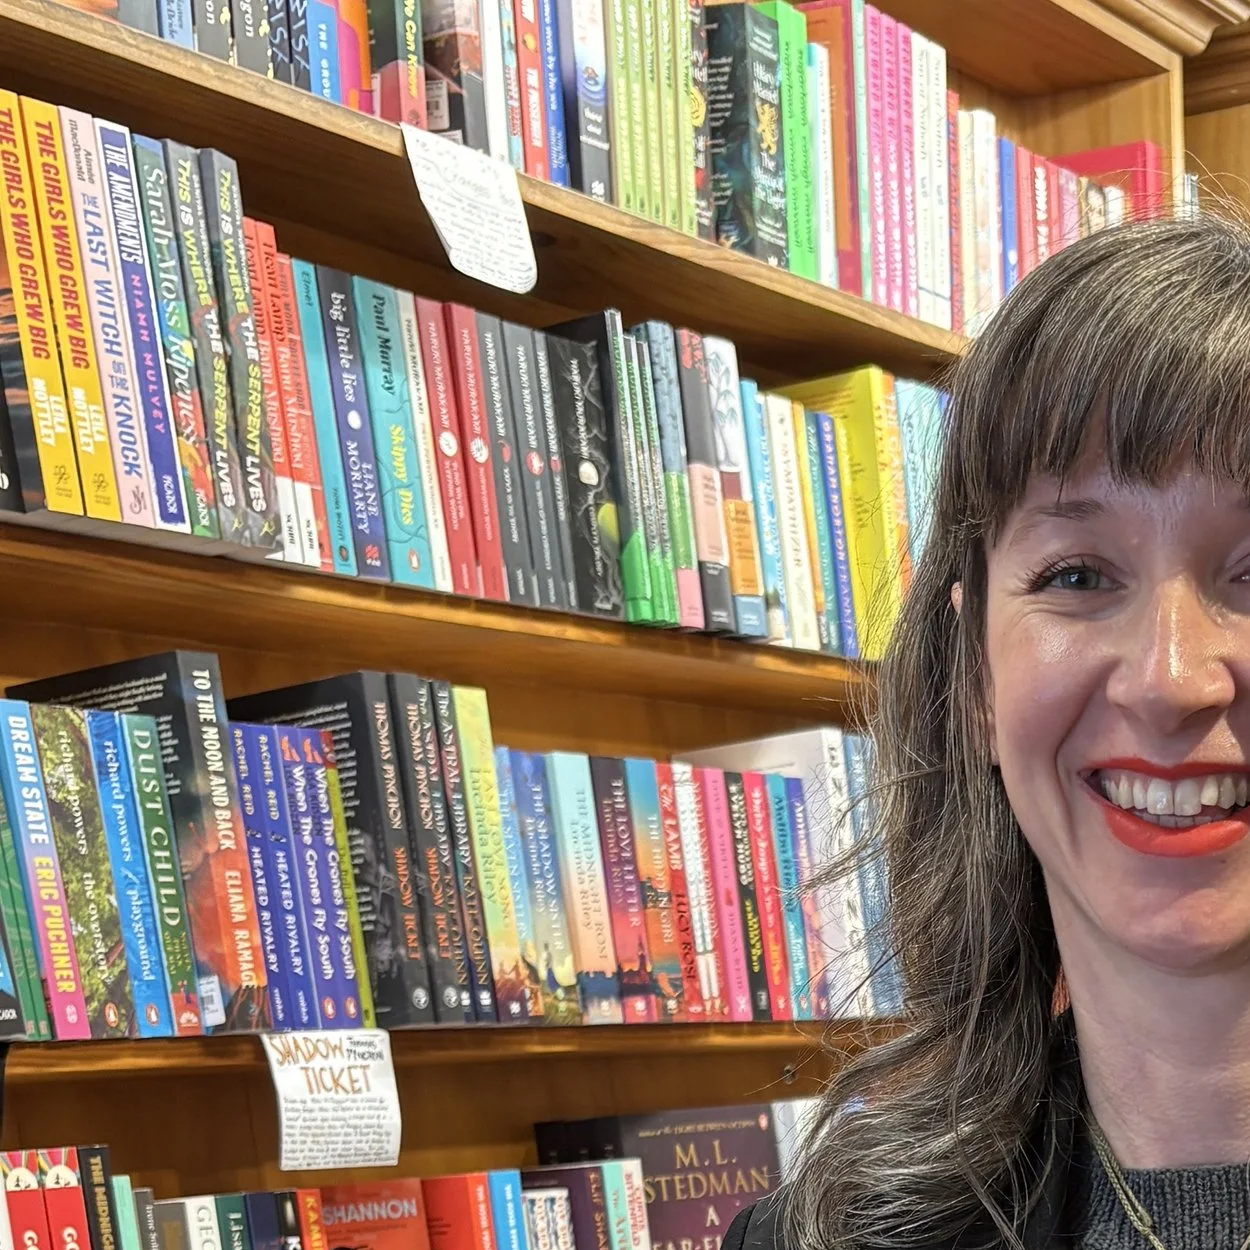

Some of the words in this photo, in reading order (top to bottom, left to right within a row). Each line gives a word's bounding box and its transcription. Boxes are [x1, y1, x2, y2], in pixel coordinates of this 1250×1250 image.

[34, 121, 57, 161] THE
[103, 143, 129, 172] THE
[2, 149, 26, 211] GIRLS
[42, 160, 64, 221] GIRLS
[145, 166, 175, 246] Sarah
[175, 158, 192, 204] THIS
[10, 212, 33, 260] WHO
[80, 206, 112, 273] LAST
[107, 169, 145, 266] AMENDMENTS
[179, 205, 194, 227] IS
[51, 220, 74, 271] WHO
[181, 229, 214, 307] WHERE
[19, 261, 45, 326] GREW
[60, 271, 85, 335] GREW
[157, 251, 183, 328] Moss
[329, 291, 346, 322] big
[371, 293, 391, 333] Paul
[28, 324, 51, 360] BIG
[93, 274, 124, 358] WITCH
[204, 308, 226, 352] THE
[69, 334, 90, 370] BIG
[335, 324, 354, 370] little
[376, 334, 397, 397] Murray
[212, 355, 230, 449] SERPENT
[342, 372, 358, 404] lies
[113, 394, 145, 479] KNOCK
[214, 449, 236, 508] LIVES
[345, 440, 370, 534] MORIARTY
[361, 462, 379, 517] LIANE
[192, 668, 213, 691] TO
[437, 686, 450, 718] The
[196, 695, 218, 724] THE
[7, 714, 38, 784] DREAM
[103, 740, 126, 801] richard
[201, 725, 225, 773] MOON
[258, 733, 275, 786] RACHEL
[441, 720, 461, 790] ASTRAL
[21, 786, 50, 846] STATE
[208, 774, 231, 809] AND
[267, 788, 280, 822] REID
[610, 777, 627, 812] THE
[111, 802, 133, 862] powers
[132, 728, 165, 816] DUST
[150, 826, 182, 927] CHILD
[214, 810, 237, 851] BACK
[233, 727, 249, 780] RACHEL
[241, 783, 256, 817] REID
[250, 846, 270, 908] HEATED
[260, 911, 281, 974] RIVALRY
[451, 792, 473, 868] LIBRARY
[615, 816, 635, 861] LOVE
[33, 856, 60, 901] ERIC
[275, 850, 294, 912] HEATED
[463, 875, 478, 916] KATE
[623, 864, 642, 928] LETTER
[42, 904, 77, 994] PUCHNER
[125, 887, 156, 982] playground
[284, 913, 305, 977] RIVALRY
[470, 927, 489, 985] QUINN
[268, 1033, 345, 1068] SHADOW
[299, 1064, 372, 1096] TICKET
[90, 1155, 106, 1185] THE
[589, 1171, 602, 1210] ELIF
[644, 1165, 771, 1204] STEDMAN
[321, 1198, 418, 1226] SHANNON
[705, 1204, 721, 1228] A
